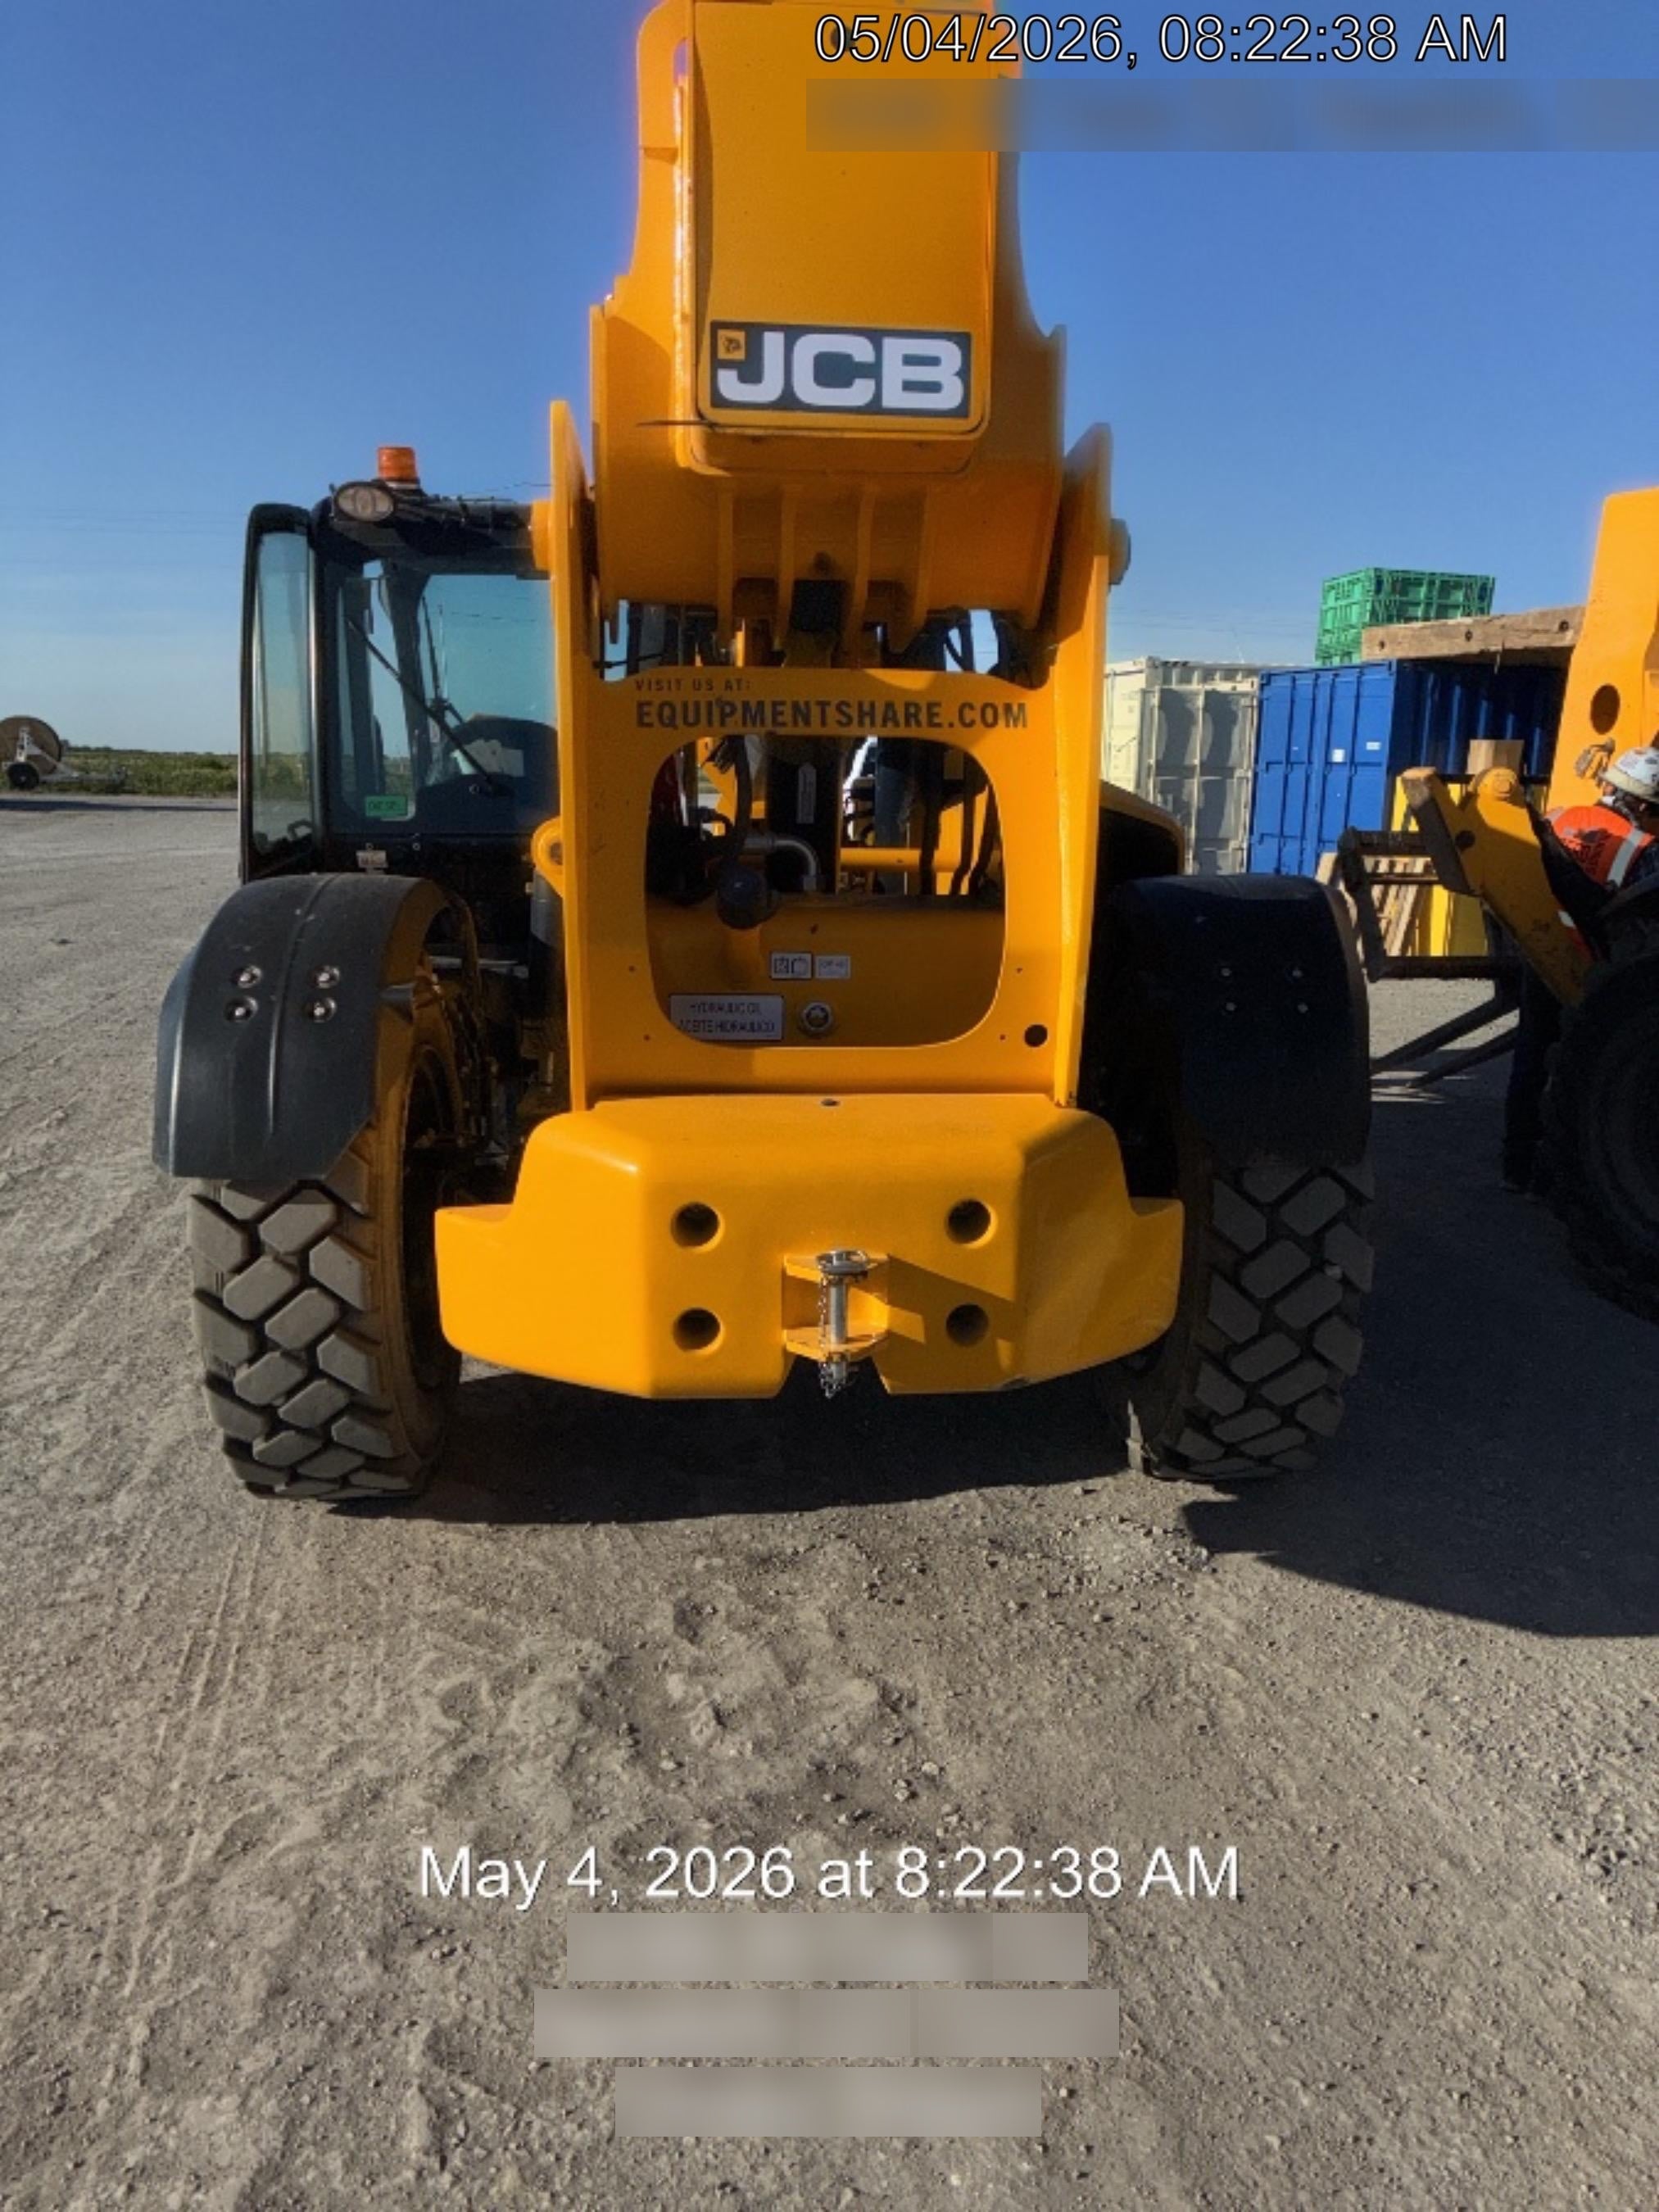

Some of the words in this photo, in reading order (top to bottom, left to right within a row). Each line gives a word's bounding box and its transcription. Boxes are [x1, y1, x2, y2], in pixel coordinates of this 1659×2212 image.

[717, 331, 964, 410] JCB
[635, 678, 682, 691] VISIT
[692, 678, 714, 691] US
[724, 678, 750, 691] AT:
[636, 700, 1027, 729] EQUIPMENTSHARE.COM
